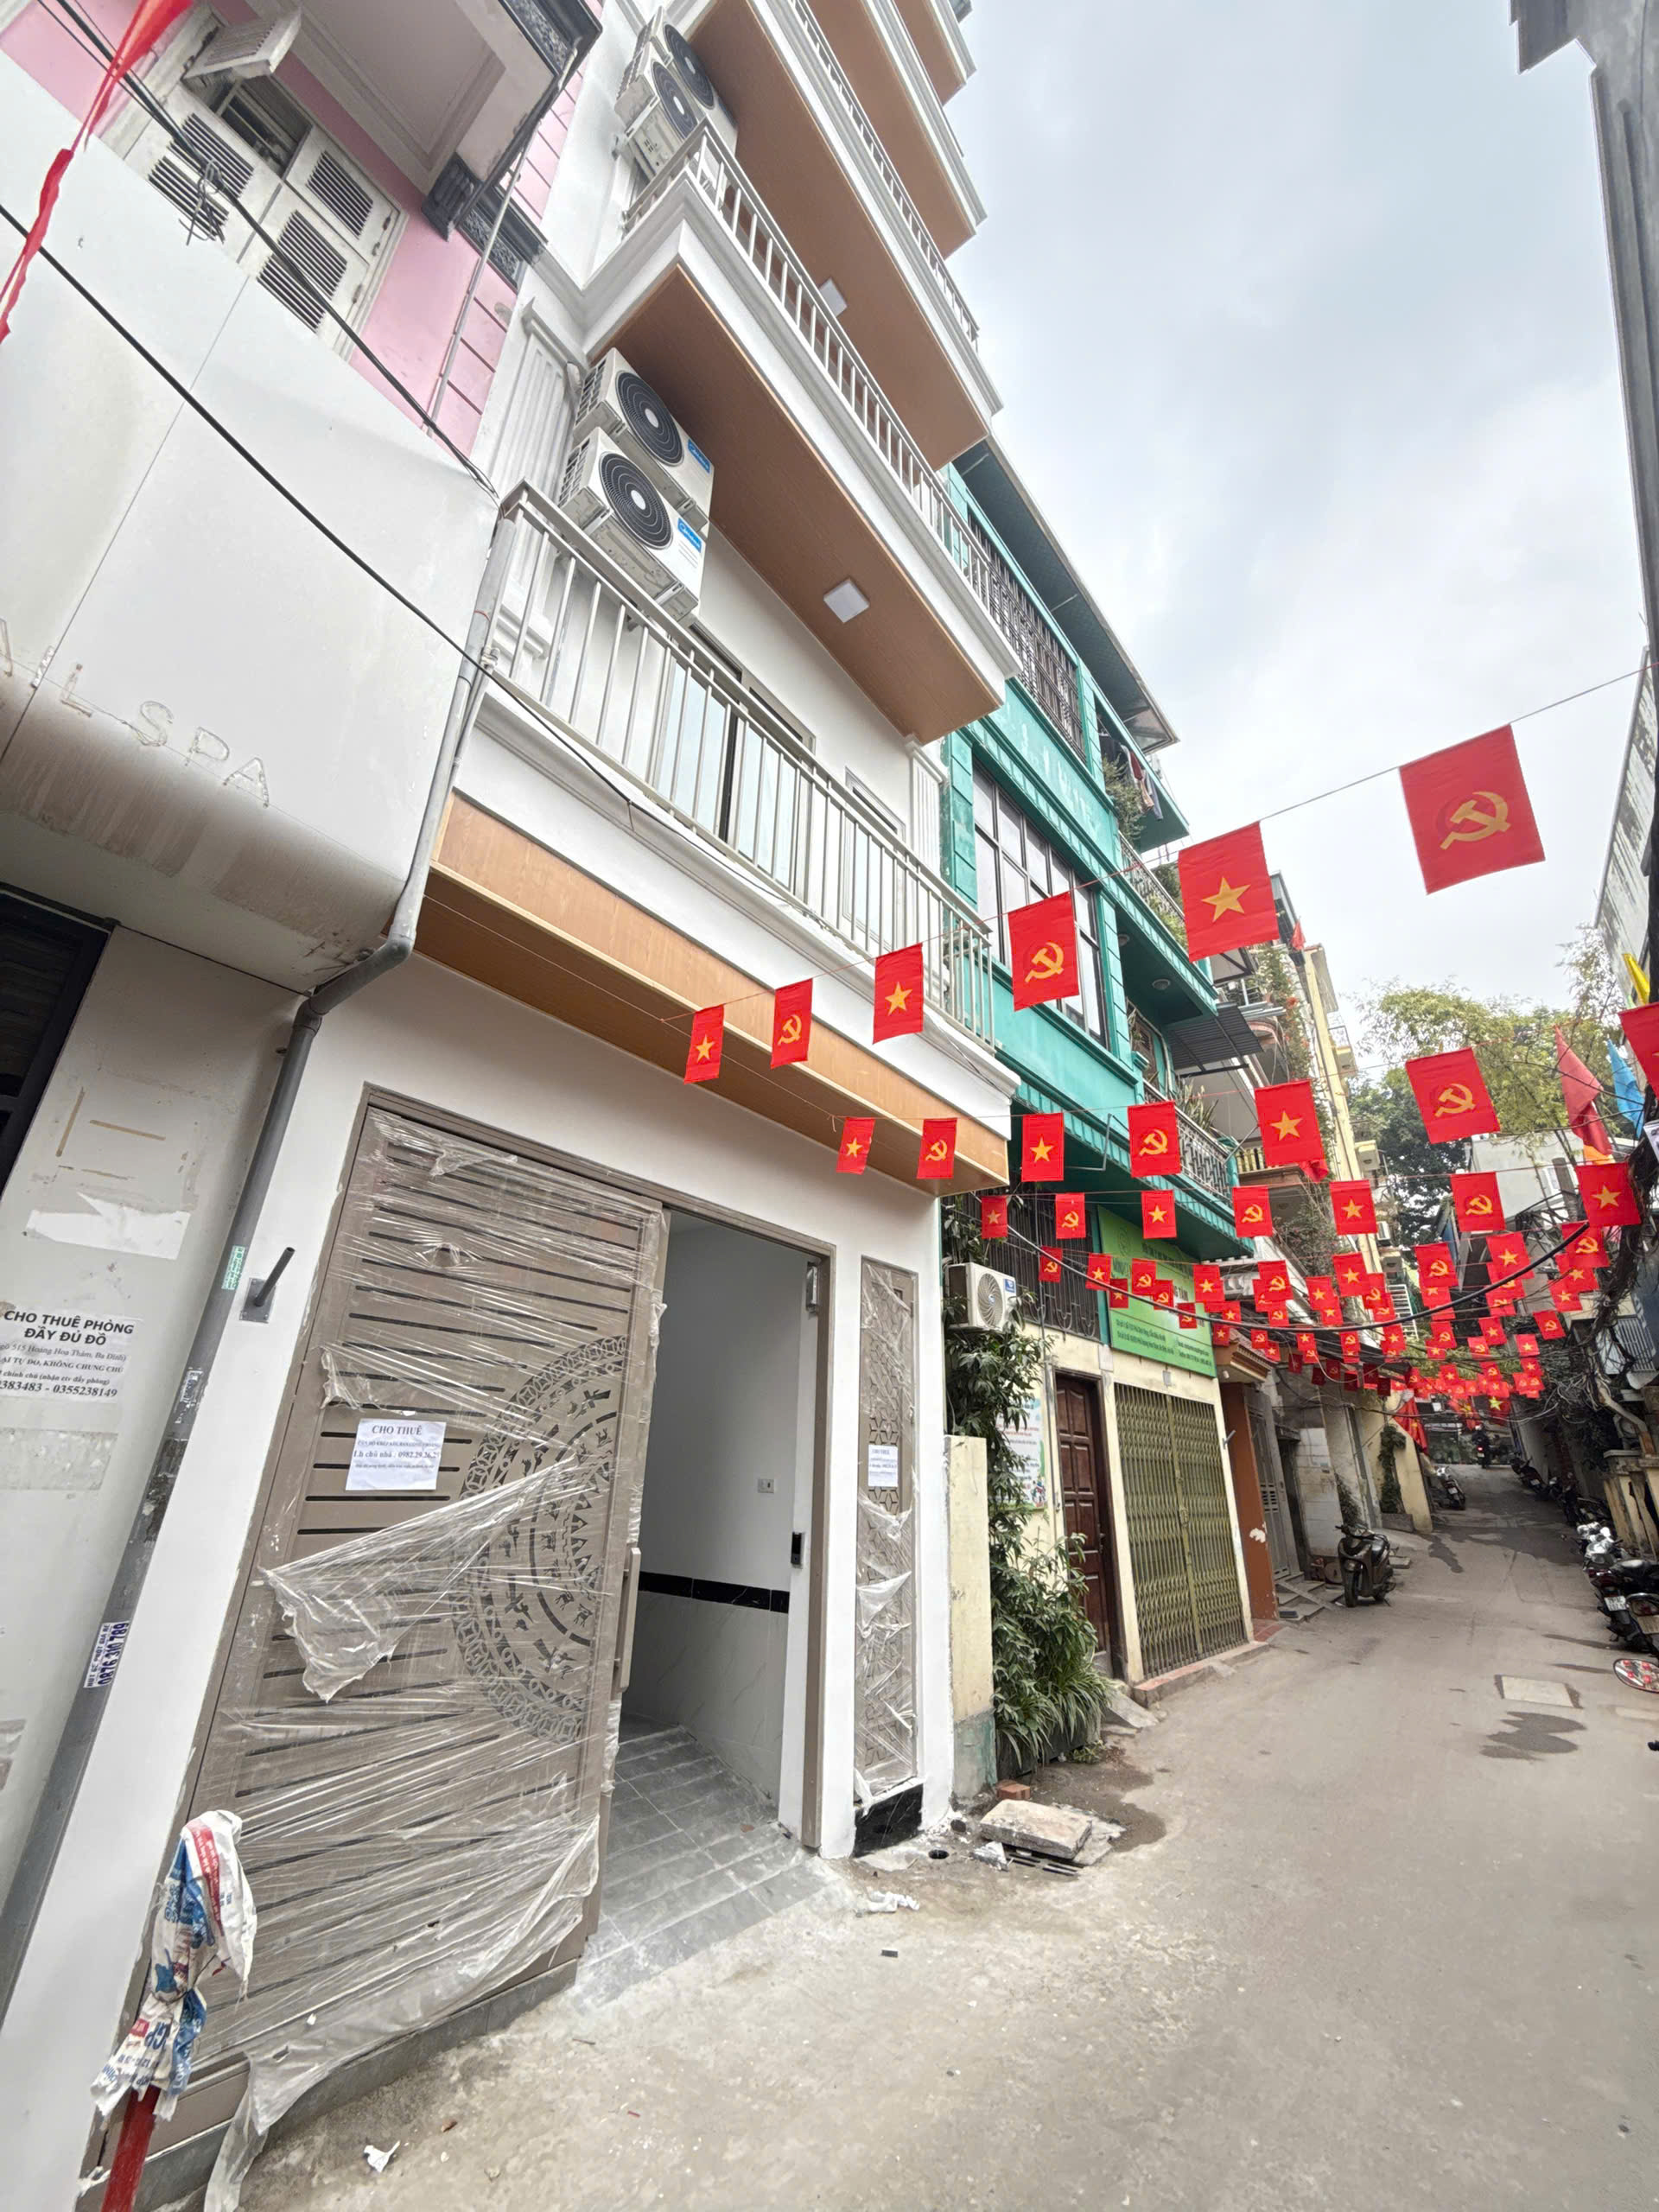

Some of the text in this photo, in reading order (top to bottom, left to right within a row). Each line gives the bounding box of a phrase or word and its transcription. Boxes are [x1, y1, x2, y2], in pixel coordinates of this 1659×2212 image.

[138, 698, 270, 809] SPA
[3, 1310, 135, 1334] CHO THUÊ PHÒNG
[24, 1325, 107, 1345] ĐẦY ĐỦ ĐỒ
[43, 1359, 73, 1369] KHÔNG
[75, 1363, 105, 1371] CHUNG
[53, 1384, 118, 1397] 0355238149
[372, 1425, 423, 1435] CHO THUÊ
[109, 1623, 130, 1642] 789
